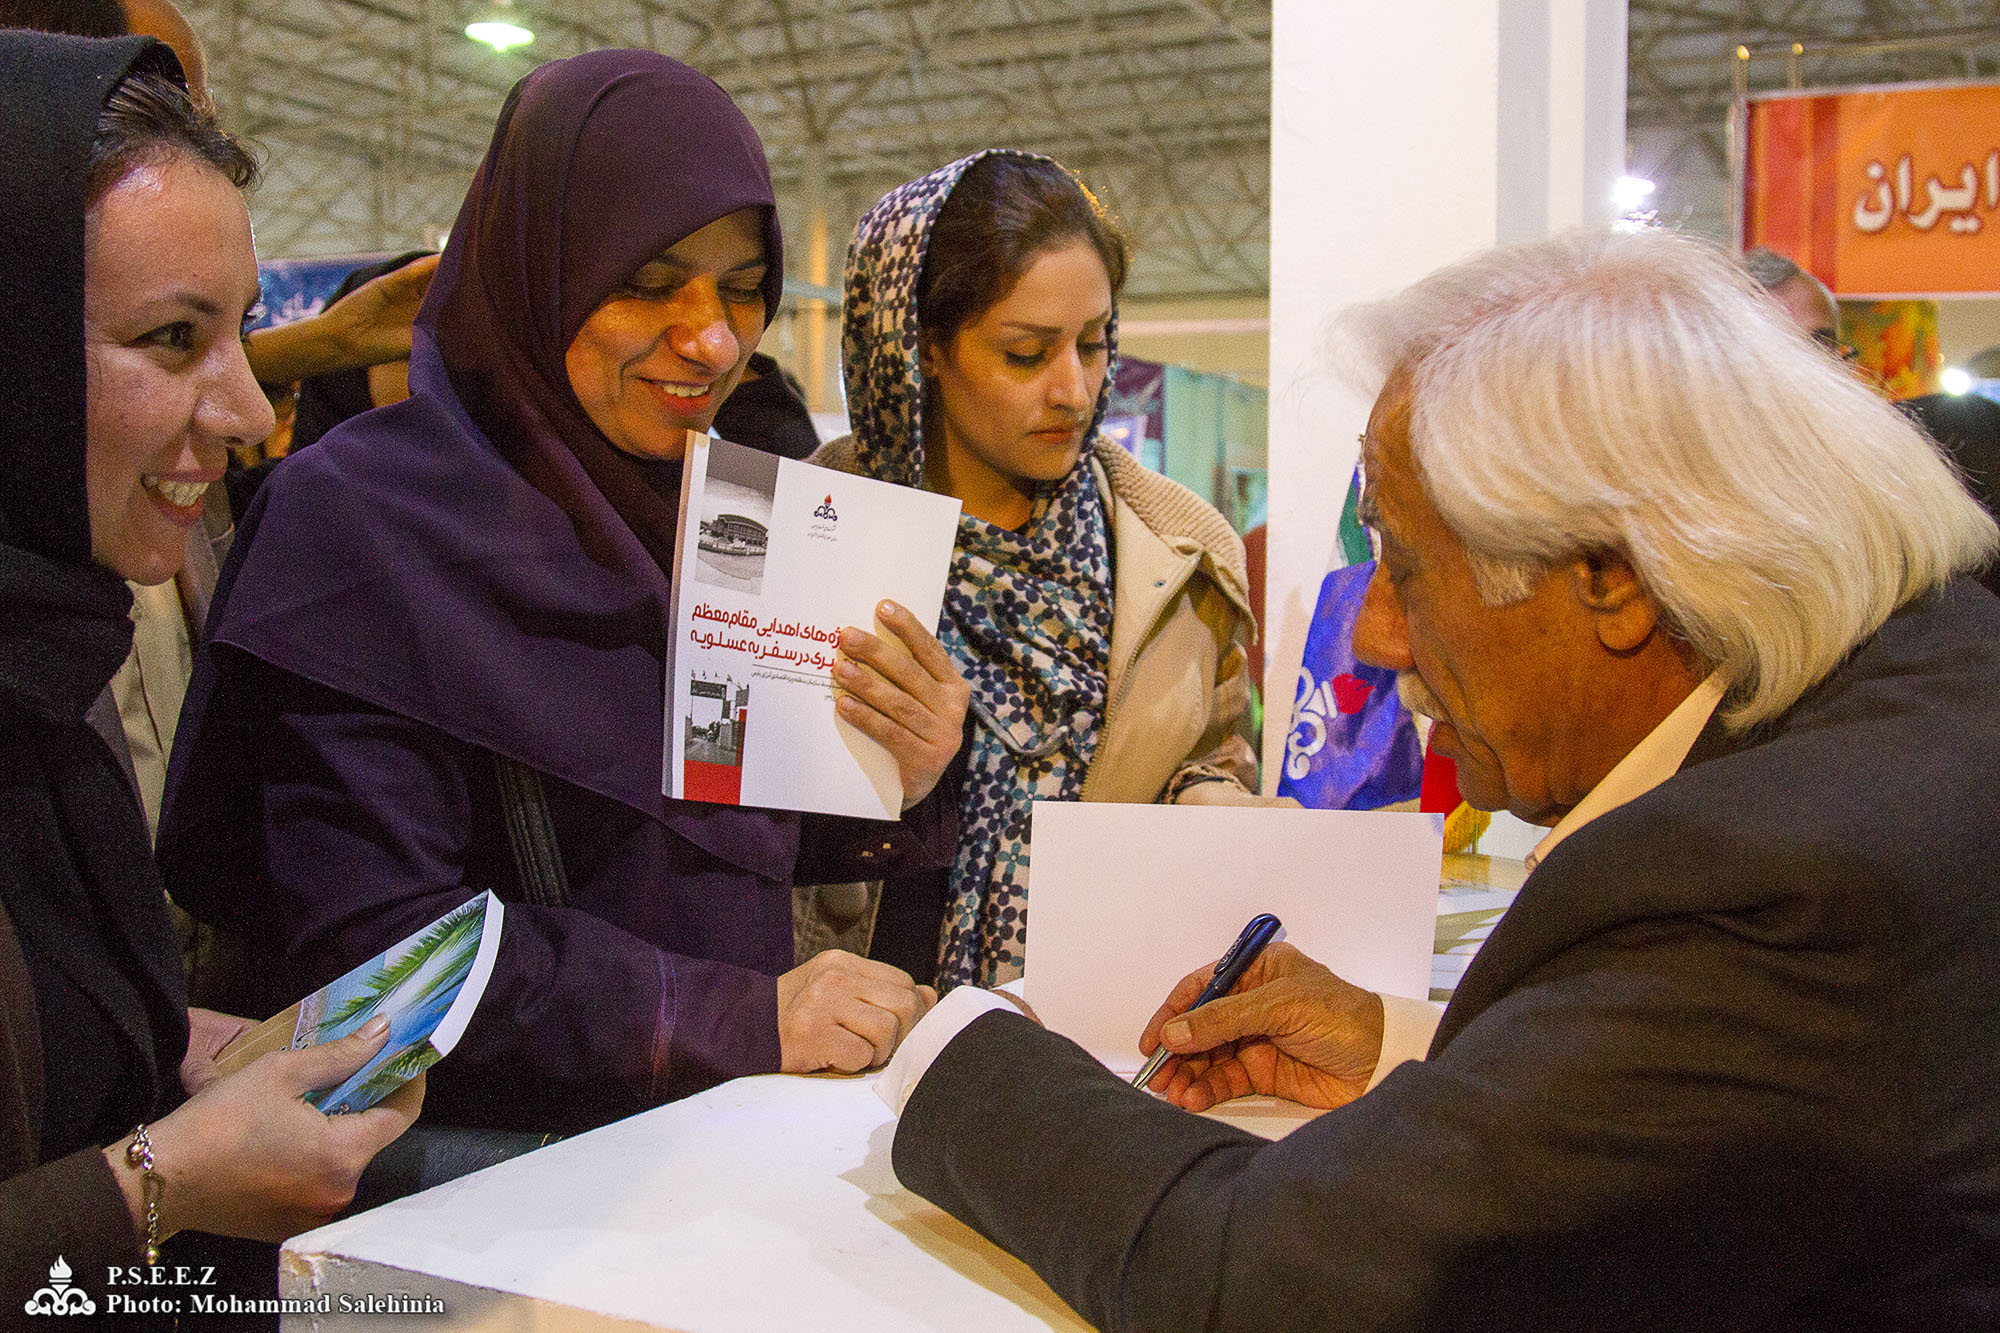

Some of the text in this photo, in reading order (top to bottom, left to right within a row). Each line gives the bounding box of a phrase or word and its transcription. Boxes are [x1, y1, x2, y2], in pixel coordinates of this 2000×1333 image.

[1853, 150, 1999, 234] ایران
[691, 602, 730, 623] معظم
[728, 608, 758, 629] مقام
[756, 617, 800, 638] اهدایی
[690, 629, 748, 652] عسلویه
[747, 641, 760, 660] به
[759, 640, 797, 660] سفر
[795, 652, 810, 667] در
